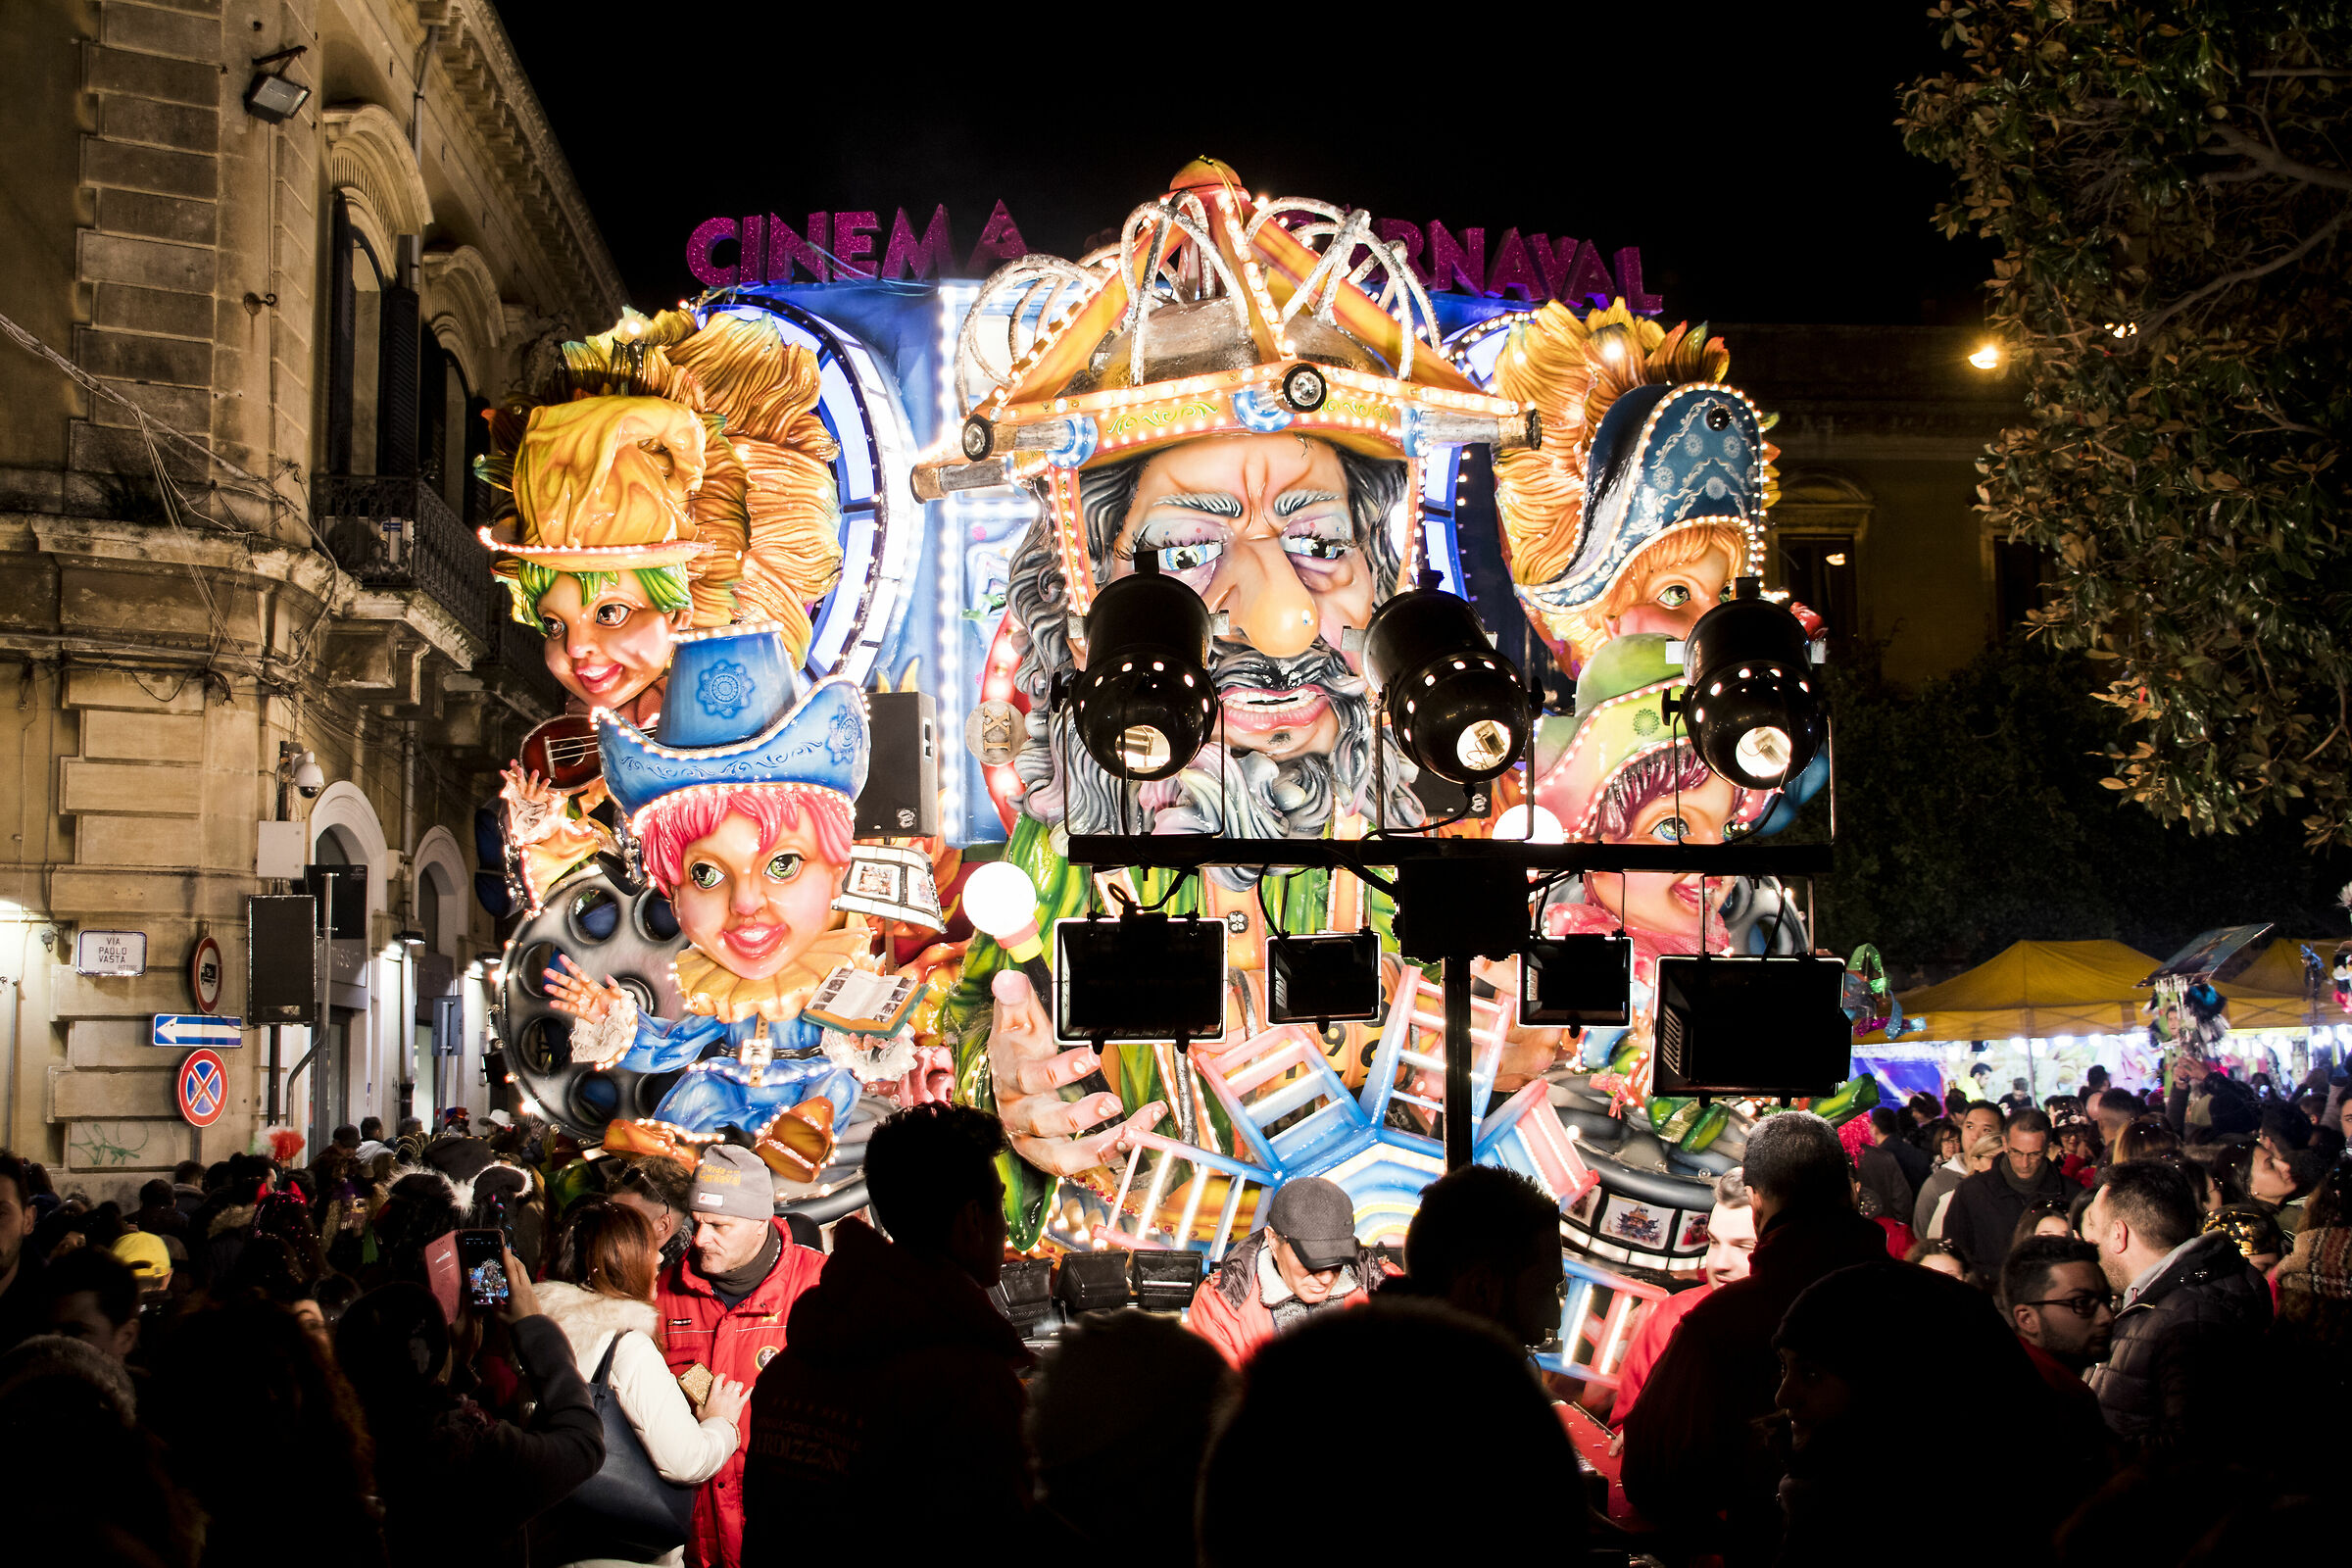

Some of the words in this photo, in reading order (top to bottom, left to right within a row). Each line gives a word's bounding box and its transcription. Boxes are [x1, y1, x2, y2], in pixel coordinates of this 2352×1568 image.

[686, 198, 1033, 287] CINEMA
[1272, 204, 1663, 315] RNAVAL
[106, 937, 121, 946] VIA
[98, 947, 127, 956] PAOLO
[98, 955, 126, 963] VASTA
